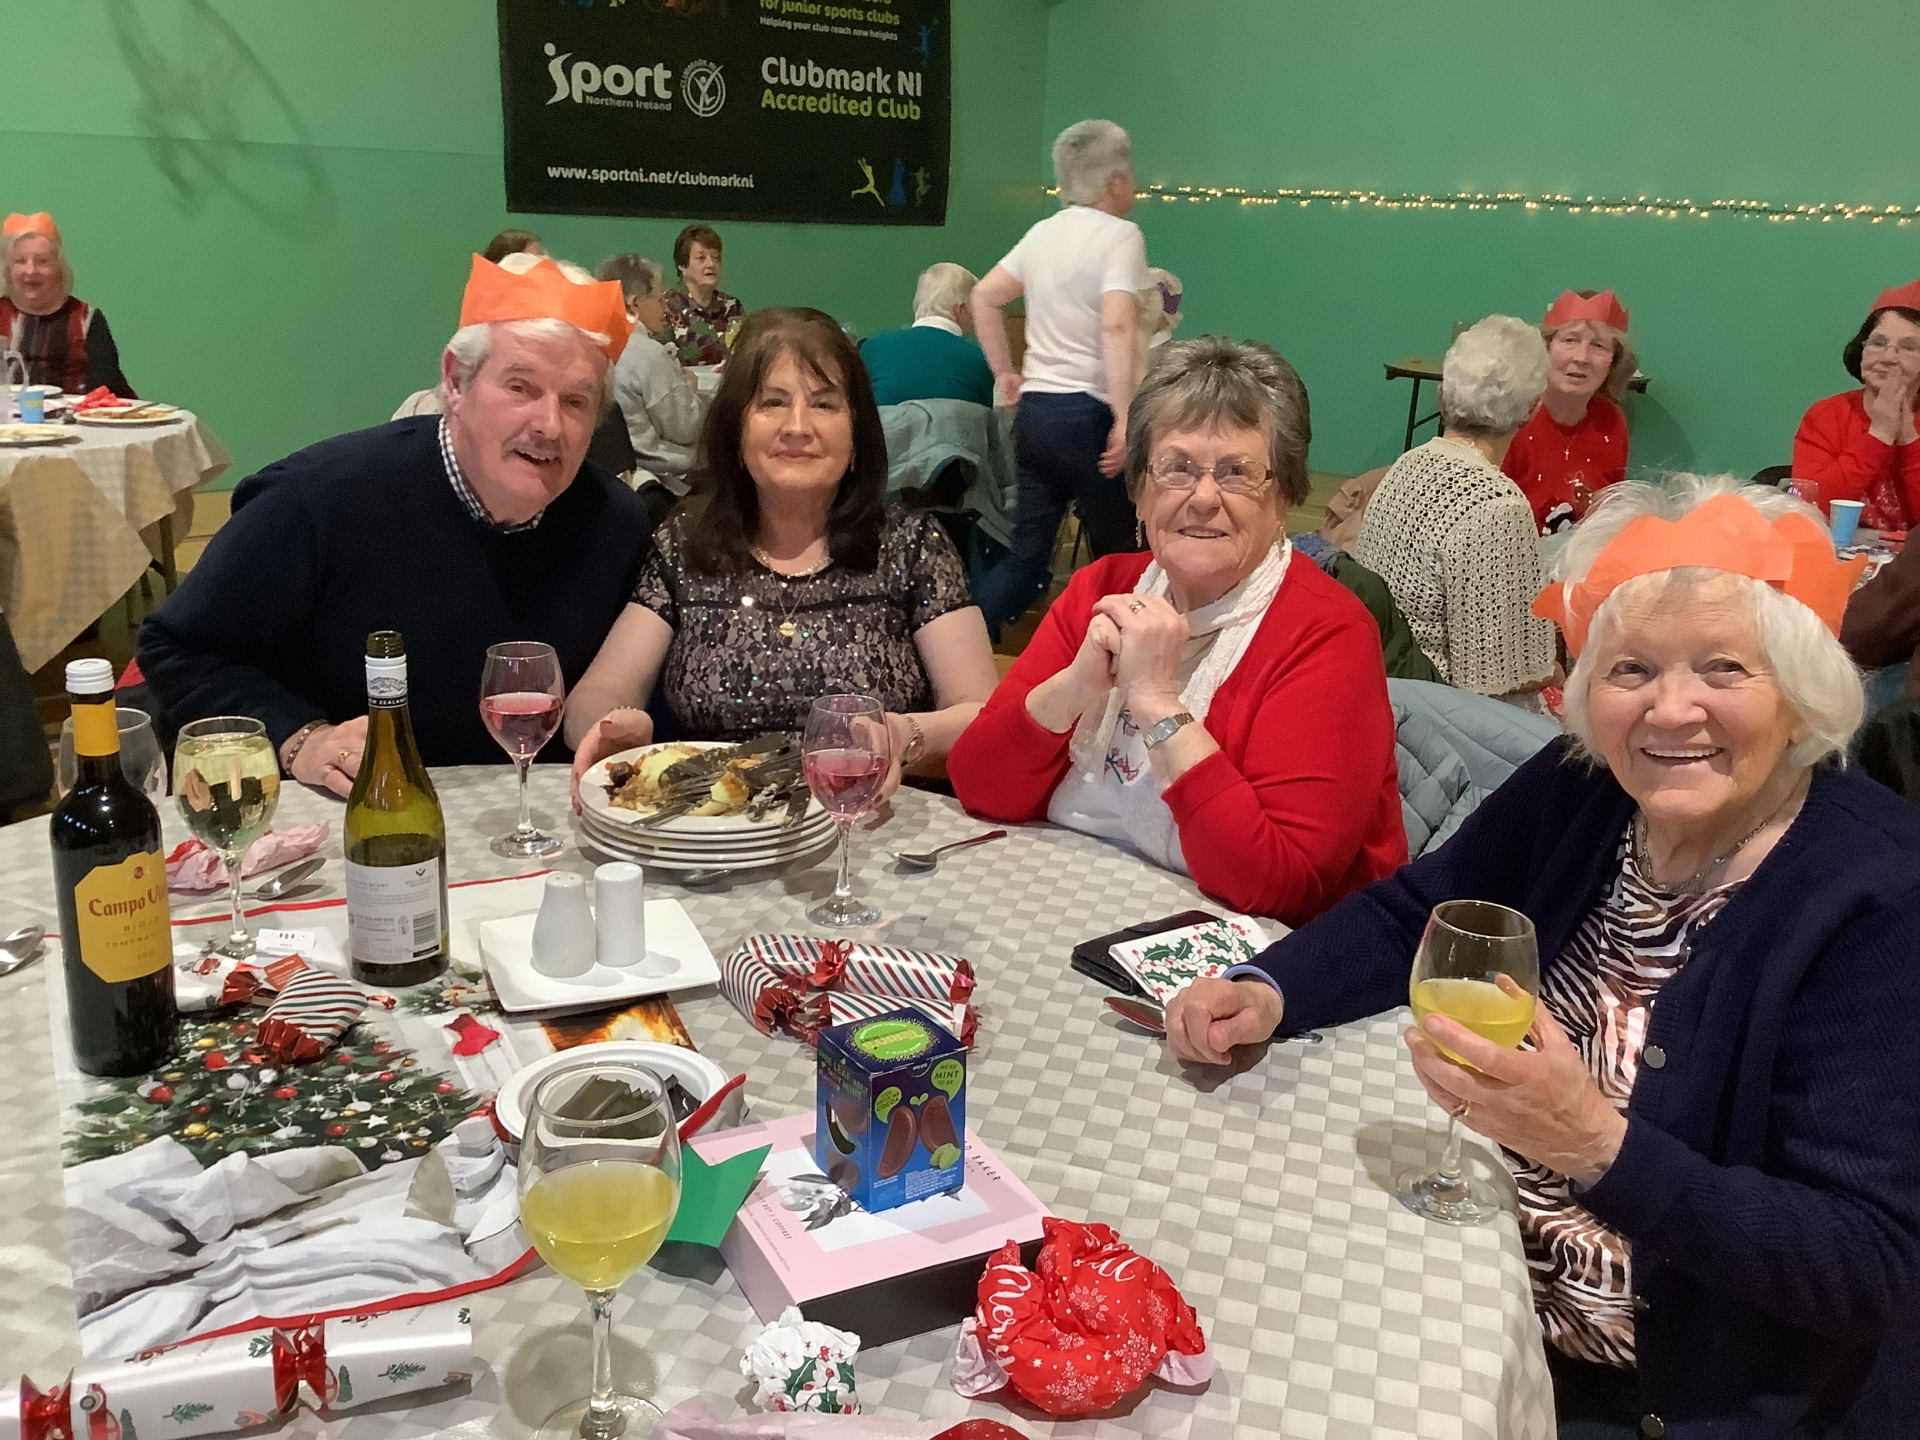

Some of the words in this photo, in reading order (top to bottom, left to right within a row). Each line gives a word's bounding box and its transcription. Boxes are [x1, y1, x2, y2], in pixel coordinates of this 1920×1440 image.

[781, 0, 822, 14] junior
[824, 5, 864, 20] sports
[866, 9, 900, 25] clubs
[759, 16, 793, 30] Helping
[793, 22, 811, 31] your
[812, 23, 830, 33] club
[830, 26, 852, 36] reach
[853, 30, 869, 38] new
[869, 30, 899, 41] heights
[543, 42, 673, 106] Sport
[761, 56, 892, 95] Clubmark
[897, 70, 922, 98] NI
[586, 95, 634, 108] Northern
[636, 101, 672, 111] Ireland
[761, 88, 873, 117] Accredited
[877, 98, 921, 120] Club
[547, 166, 755, 188] www.sportni.net/clubmarkni
[89, 896, 146, 918] Campo
[934, 1070, 960, 1080] MINT
[940, 1063, 957, 1071] WE'RE
[876, 1097, 900, 1113] COCOA
[971, 1154, 1001, 1181] BAKER
